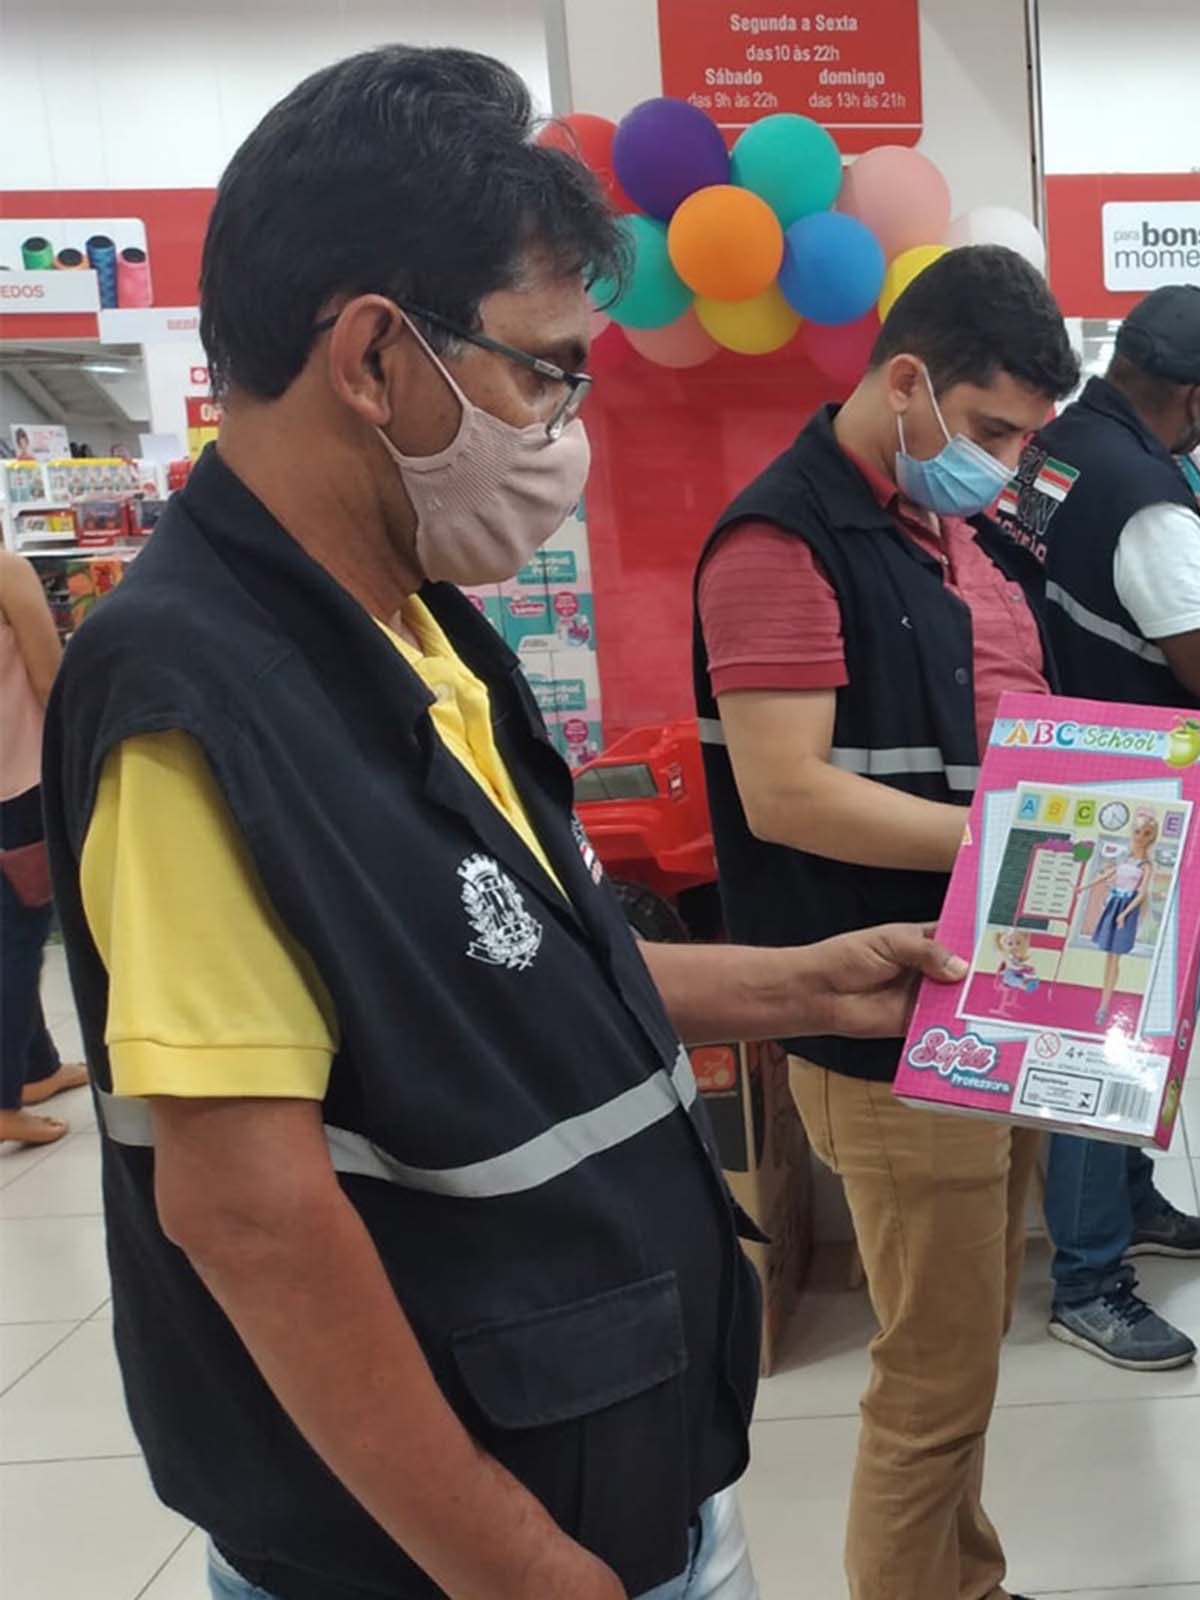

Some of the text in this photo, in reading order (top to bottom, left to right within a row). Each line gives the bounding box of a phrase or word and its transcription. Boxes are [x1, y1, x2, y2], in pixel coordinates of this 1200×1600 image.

[730, 14, 858, 34] Segunda a Sexta
[746, 45, 840, 61] das 10 às 22h
[705, 67, 763, 85] Sábado
[819, 68, 885, 87] domingo
[688, 92, 778, 108] das 9h às 22h
[808, 92, 906, 108] das 13h às 21h
[1113, 230, 1139, 243] para
[1004, 720, 1155, 751] ABC School
[910, 1028, 997, 1074] Sofia
